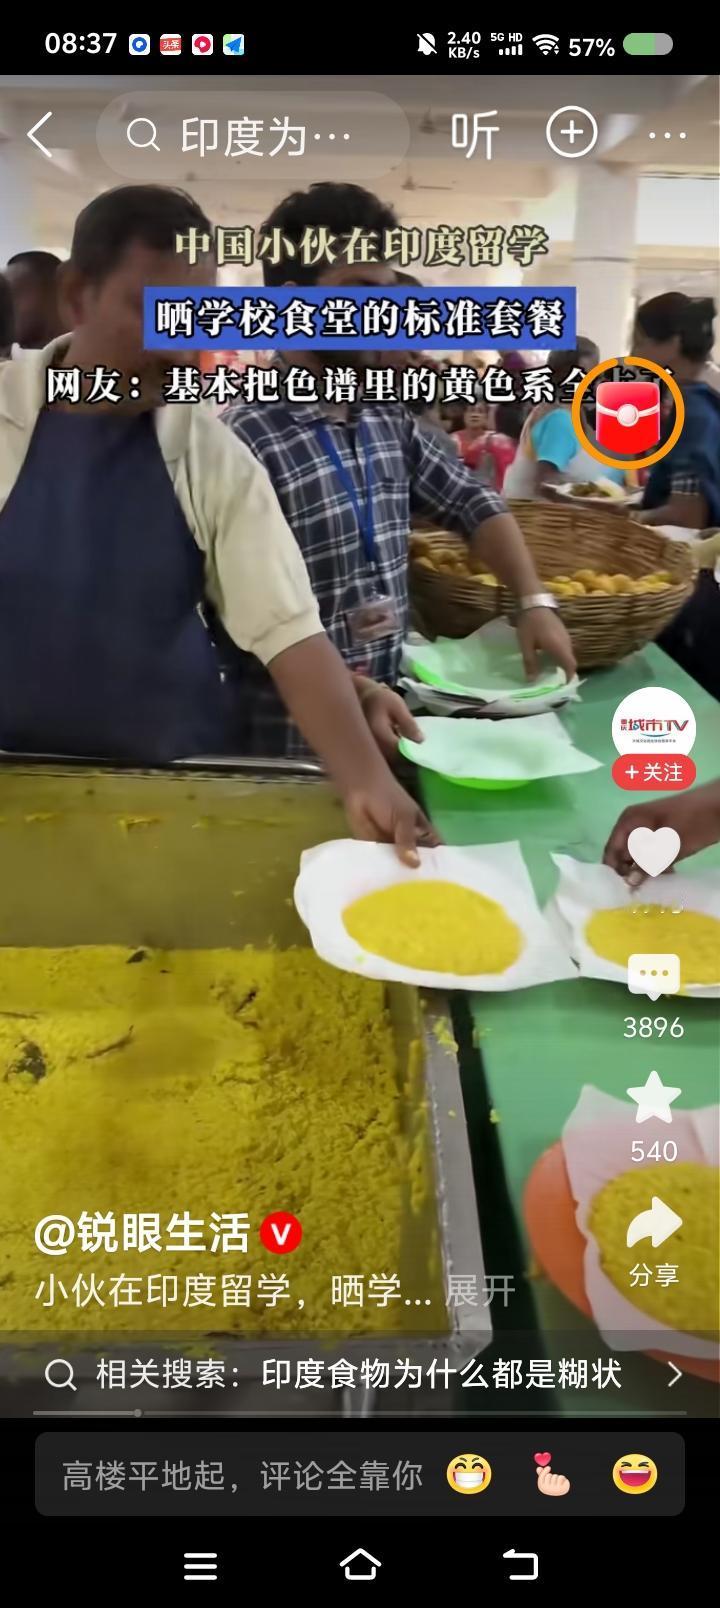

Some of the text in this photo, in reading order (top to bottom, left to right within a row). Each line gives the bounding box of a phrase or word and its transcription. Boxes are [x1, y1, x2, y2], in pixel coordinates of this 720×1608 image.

[44, 32, 117, 54] 08:37
[447, 31, 482, 45] 2.40
[490, 32, 523, 42] 5G HD
[568, 38, 616, 57] 57%
[448, 46, 480, 60] KB/s
[451, 110, 500, 160] 听
[623, 1016, 684, 1038] 3896
[630, 1140, 678, 1162] 540
[629, 1263, 680, 1287] 分享
[62, 1459, 423, 1493] 高楼平地起，评论全靠你
